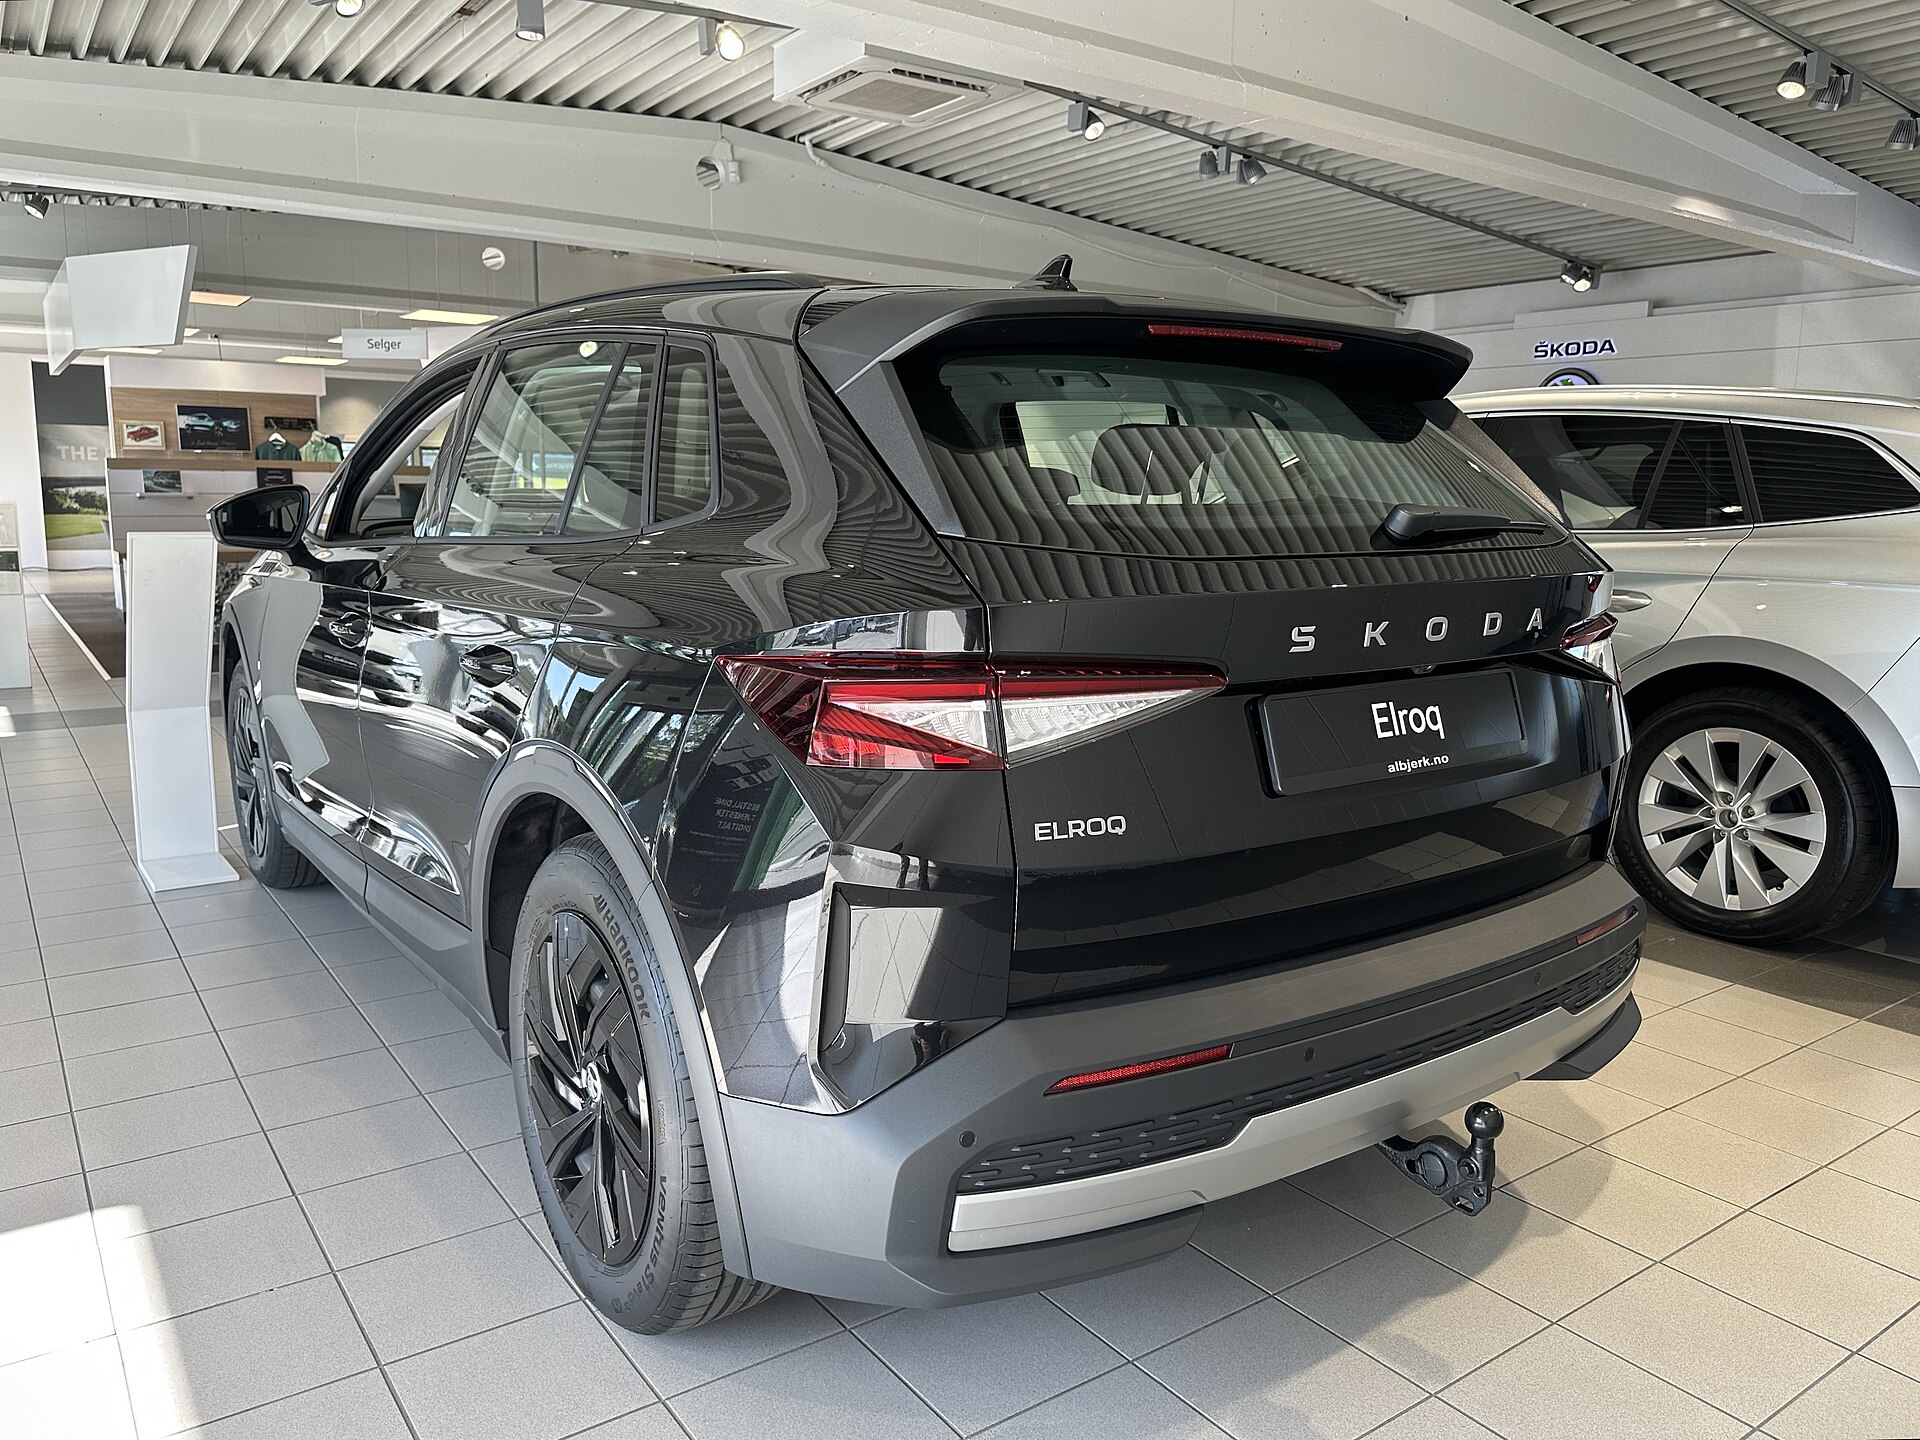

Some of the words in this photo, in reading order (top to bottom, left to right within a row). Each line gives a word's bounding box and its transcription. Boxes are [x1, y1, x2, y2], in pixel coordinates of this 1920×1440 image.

[367, 338, 402, 352] Selger
[1533, 339, 1616, 359] ŠKODA
[56, 445, 99, 461] THE
[1371, 701, 1446, 740] Elroq
[1387, 754, 1450, 773] albjerk.no
[1034, 815, 1127, 841] ELROQ
